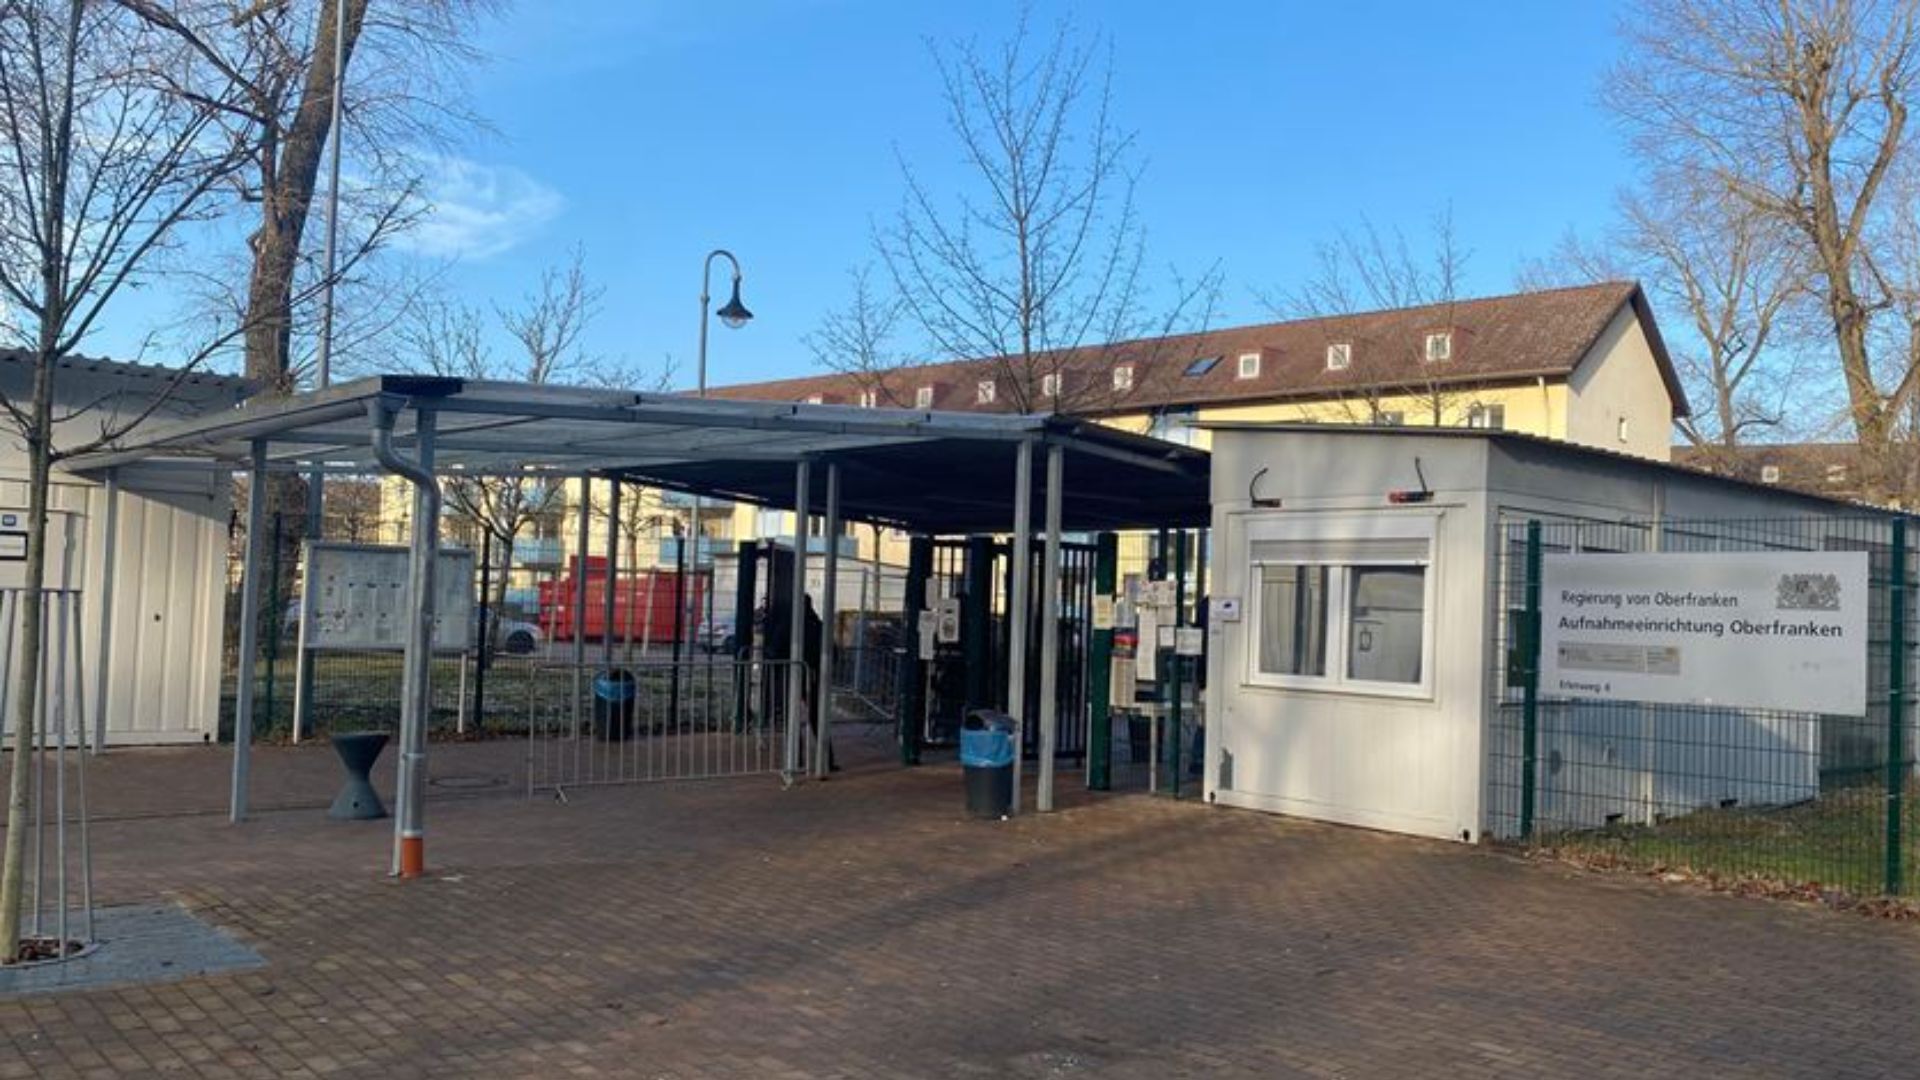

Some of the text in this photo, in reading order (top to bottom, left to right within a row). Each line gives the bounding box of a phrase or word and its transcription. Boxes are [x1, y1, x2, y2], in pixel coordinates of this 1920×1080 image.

[1561, 589, 1738, 608] Regierung von Oberfranken
[1558, 616, 1843, 638] Aufnahmeeinrichtung Oberfranken
